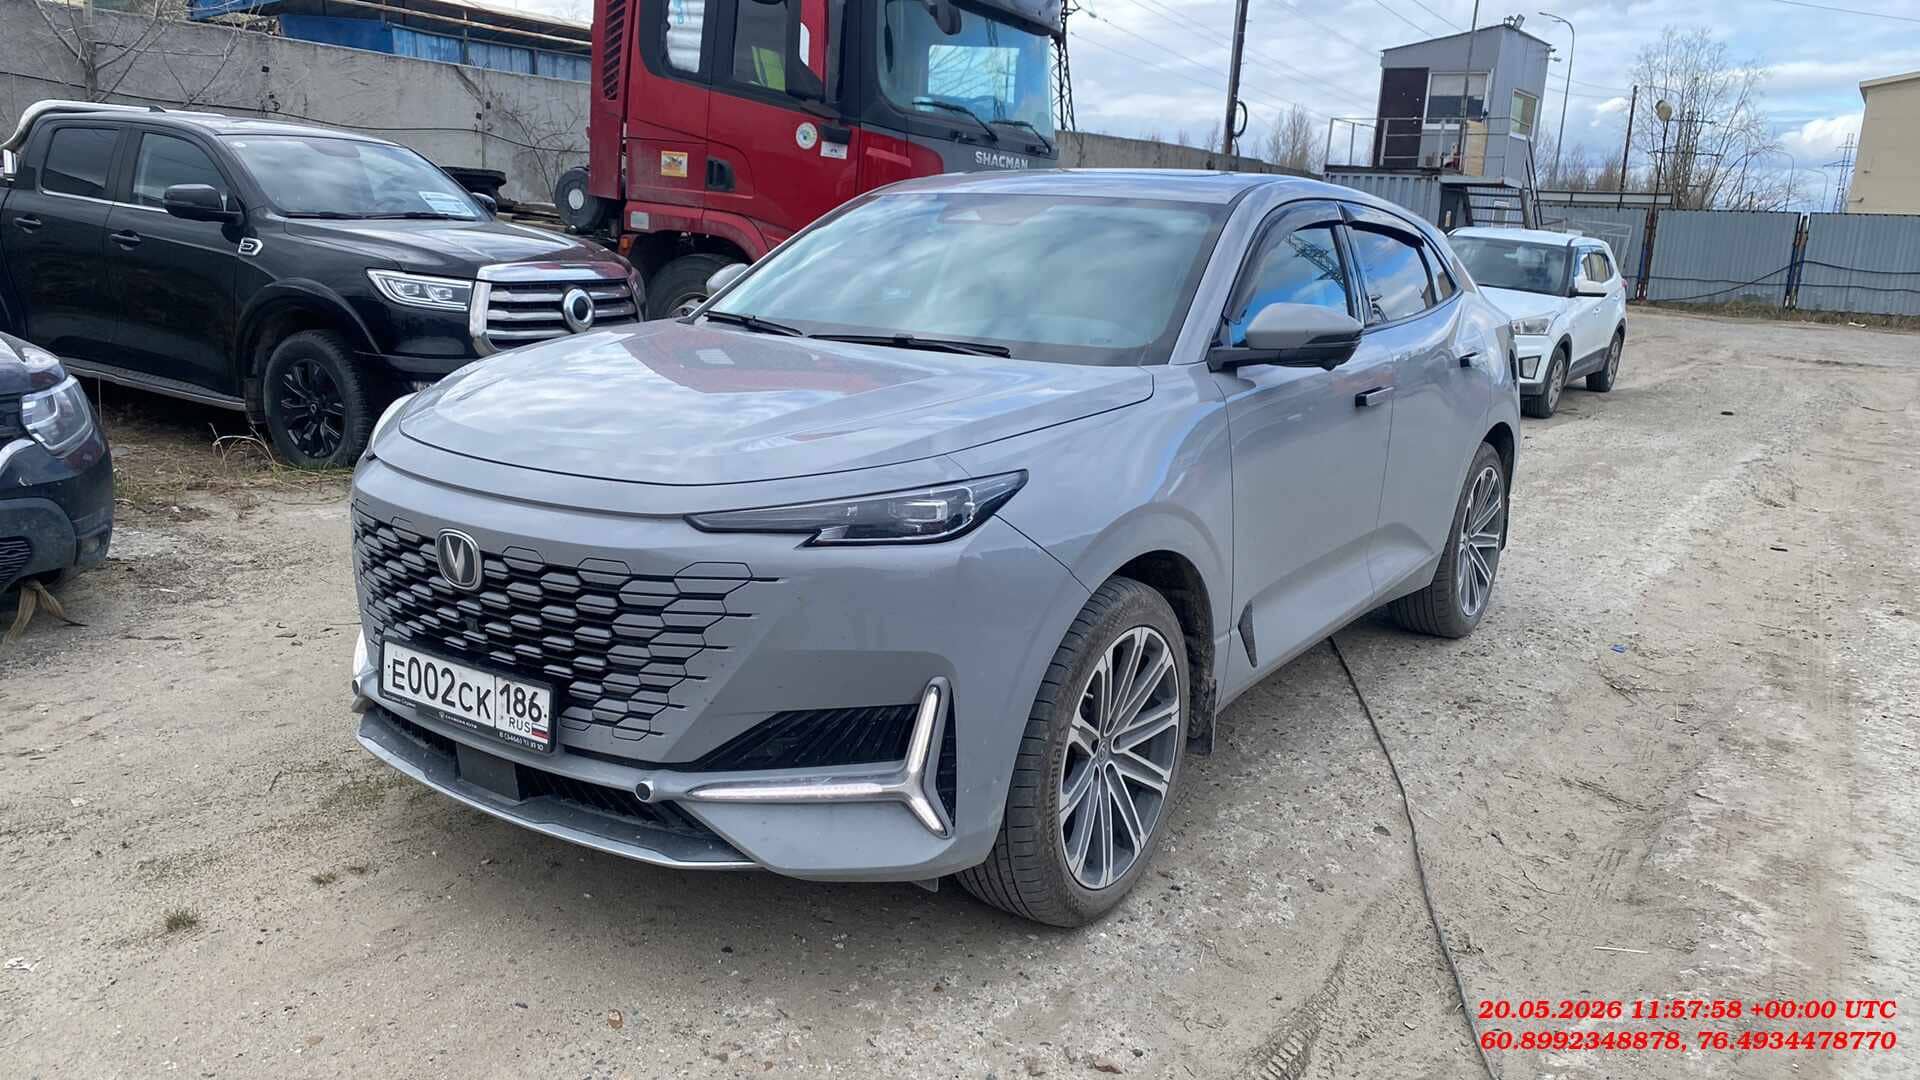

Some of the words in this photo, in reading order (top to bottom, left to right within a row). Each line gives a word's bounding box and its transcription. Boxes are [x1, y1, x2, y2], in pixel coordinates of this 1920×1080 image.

[975, 151, 1029, 169] SHACMAN
[392, 656, 491, 717] Е002СК
[500, 683, 541, 722] 186
[508, 717, 531, 733] RUS
